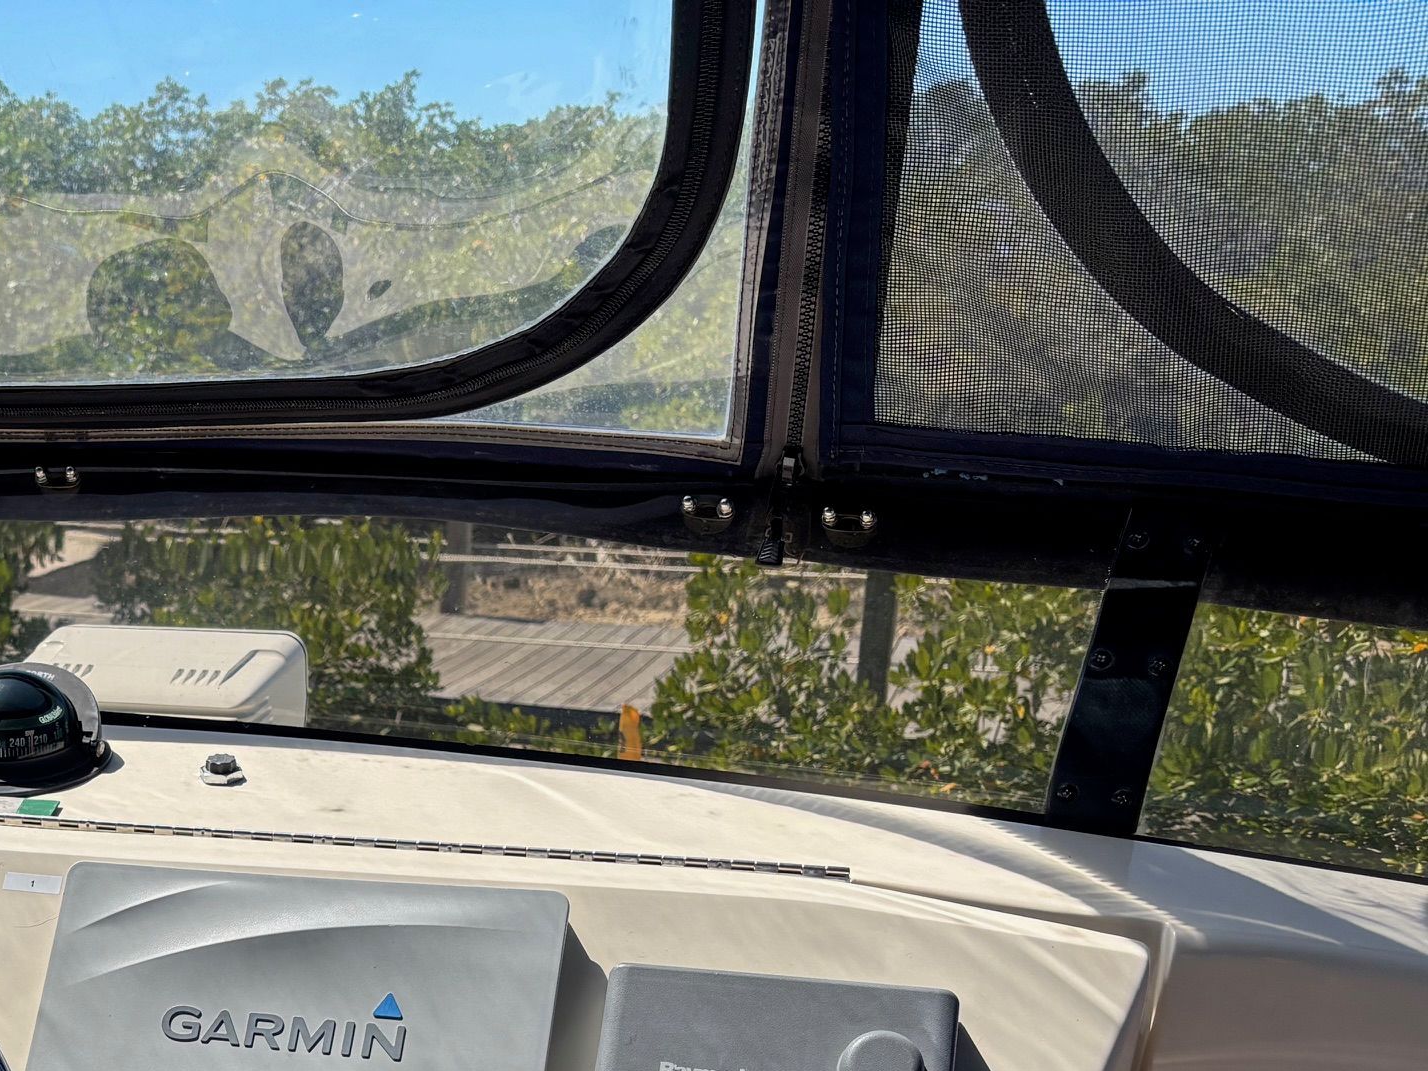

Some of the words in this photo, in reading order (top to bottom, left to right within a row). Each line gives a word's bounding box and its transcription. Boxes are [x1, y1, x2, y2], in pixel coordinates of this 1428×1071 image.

[9, 737, 26, 747] 240
[34, 733, 48, 744] 210
[30, 880, 35, 888] 1
[161, 1004, 408, 1062] GARMIN
